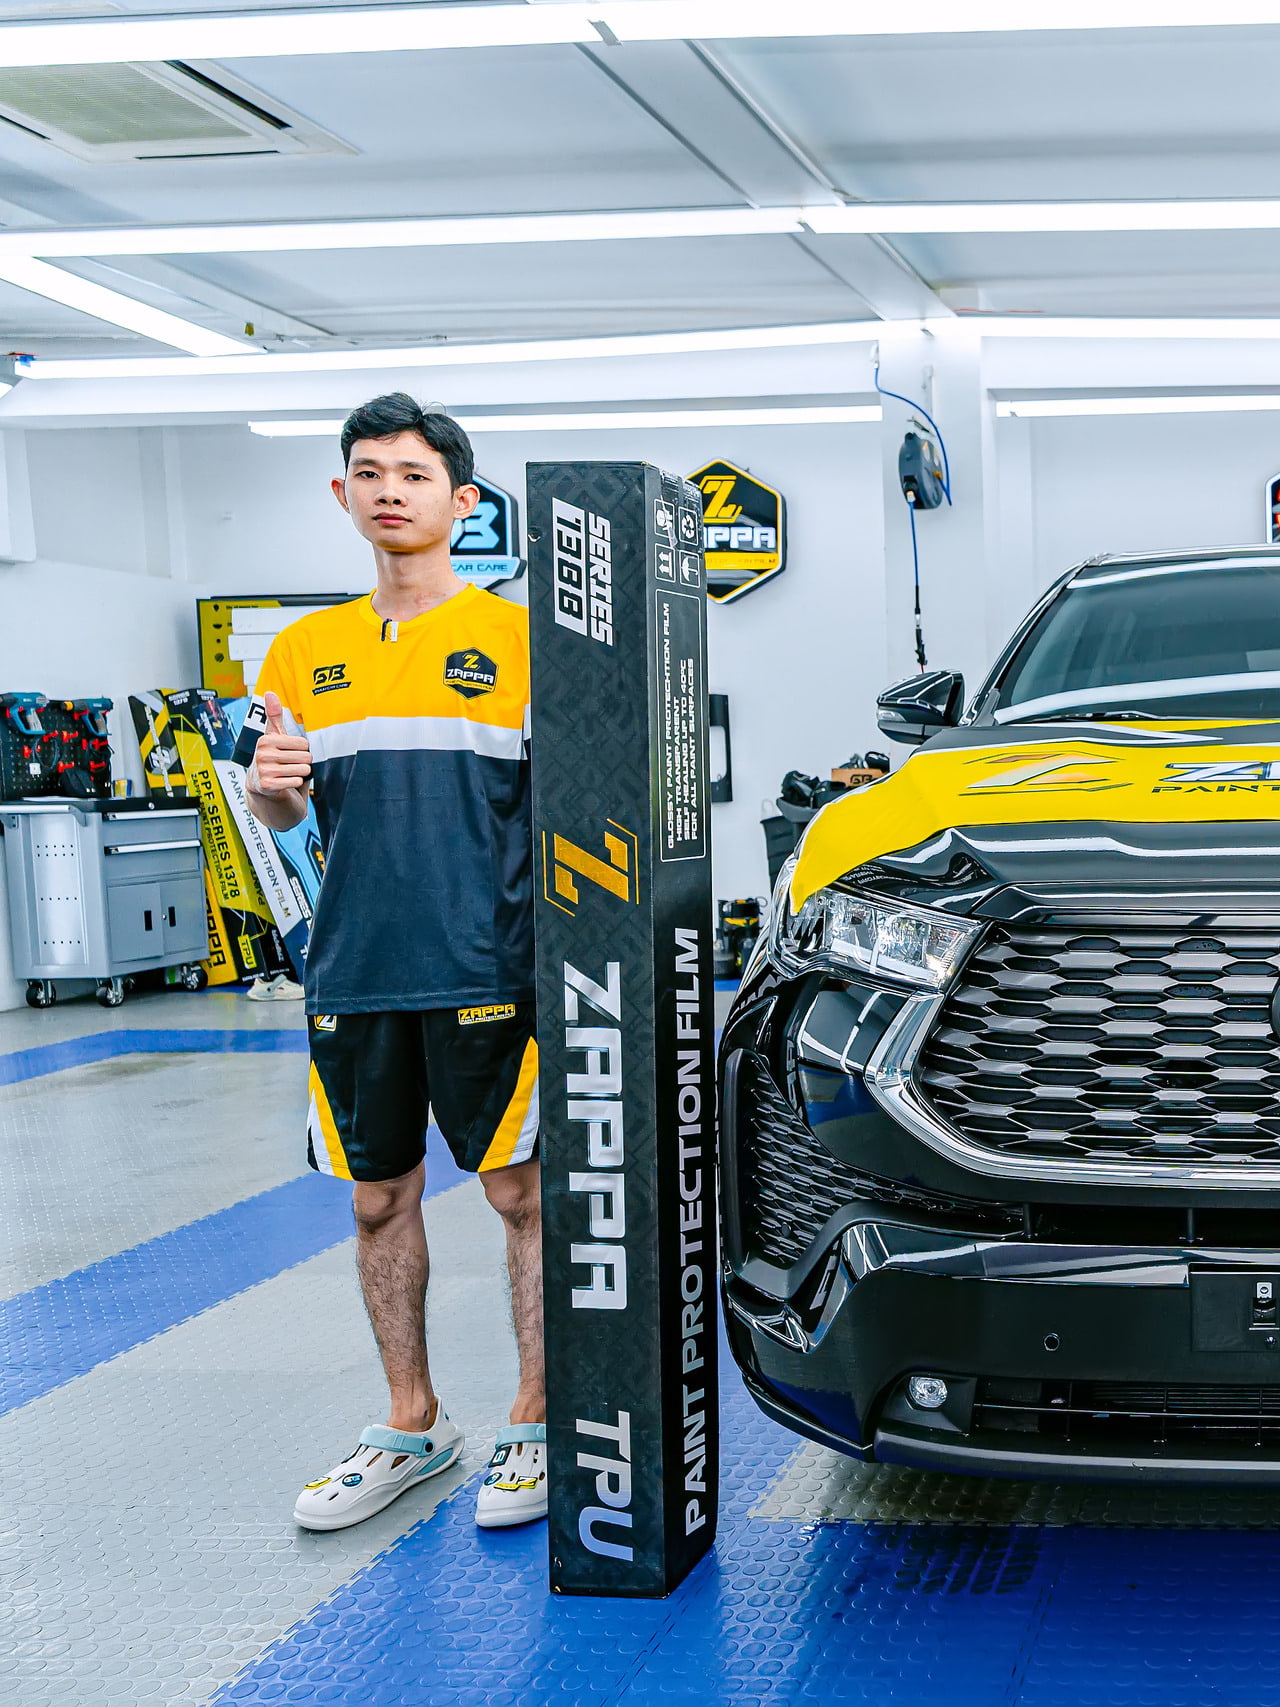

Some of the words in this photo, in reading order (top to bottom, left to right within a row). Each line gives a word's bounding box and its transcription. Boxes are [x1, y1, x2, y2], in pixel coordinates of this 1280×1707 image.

[703, 527, 776, 549] PPA
[554, 514, 585, 623] 1388
[588, 511, 614, 647] SERIES
[663, 602, 671, 636] FILM
[446, 668, 495, 685] ZAPPA
[687, 658, 696, 733] SURFACES
[681, 697, 688, 717] TO
[681, 724, 688, 740] UP
[666, 743, 674, 787] PAINT
[674, 697, 682, 805] TRANSPARENT
[682, 743, 690, 804] HEALING
[688, 737, 697, 779] PAINT
[667, 791, 675, 849] GLOSSY
[689, 782, 697, 808] ALL
[198, 769, 215, 800] PPF
[207, 804, 231, 862] SERIES
[223, 865, 240, 898] 1378
[675, 808, 683, 842] HIGH
[683, 809, 691, 841] SELF
[690, 813, 698, 840] FOR
[243, 808, 279, 888] PROTECTION
[275, 888, 292, 918] FILM
[240, 938, 254, 966] TPU
[674, 927, 701, 1040] FILM
[460, 1004, 514, 1020] ZAPPA
[563, 960, 629, 1311] ZAPPA
[677, 1050, 705, 1375] PROTECTION
[575, 1410, 634, 1562] TPU
[682, 1384, 707, 1537] PAINT
